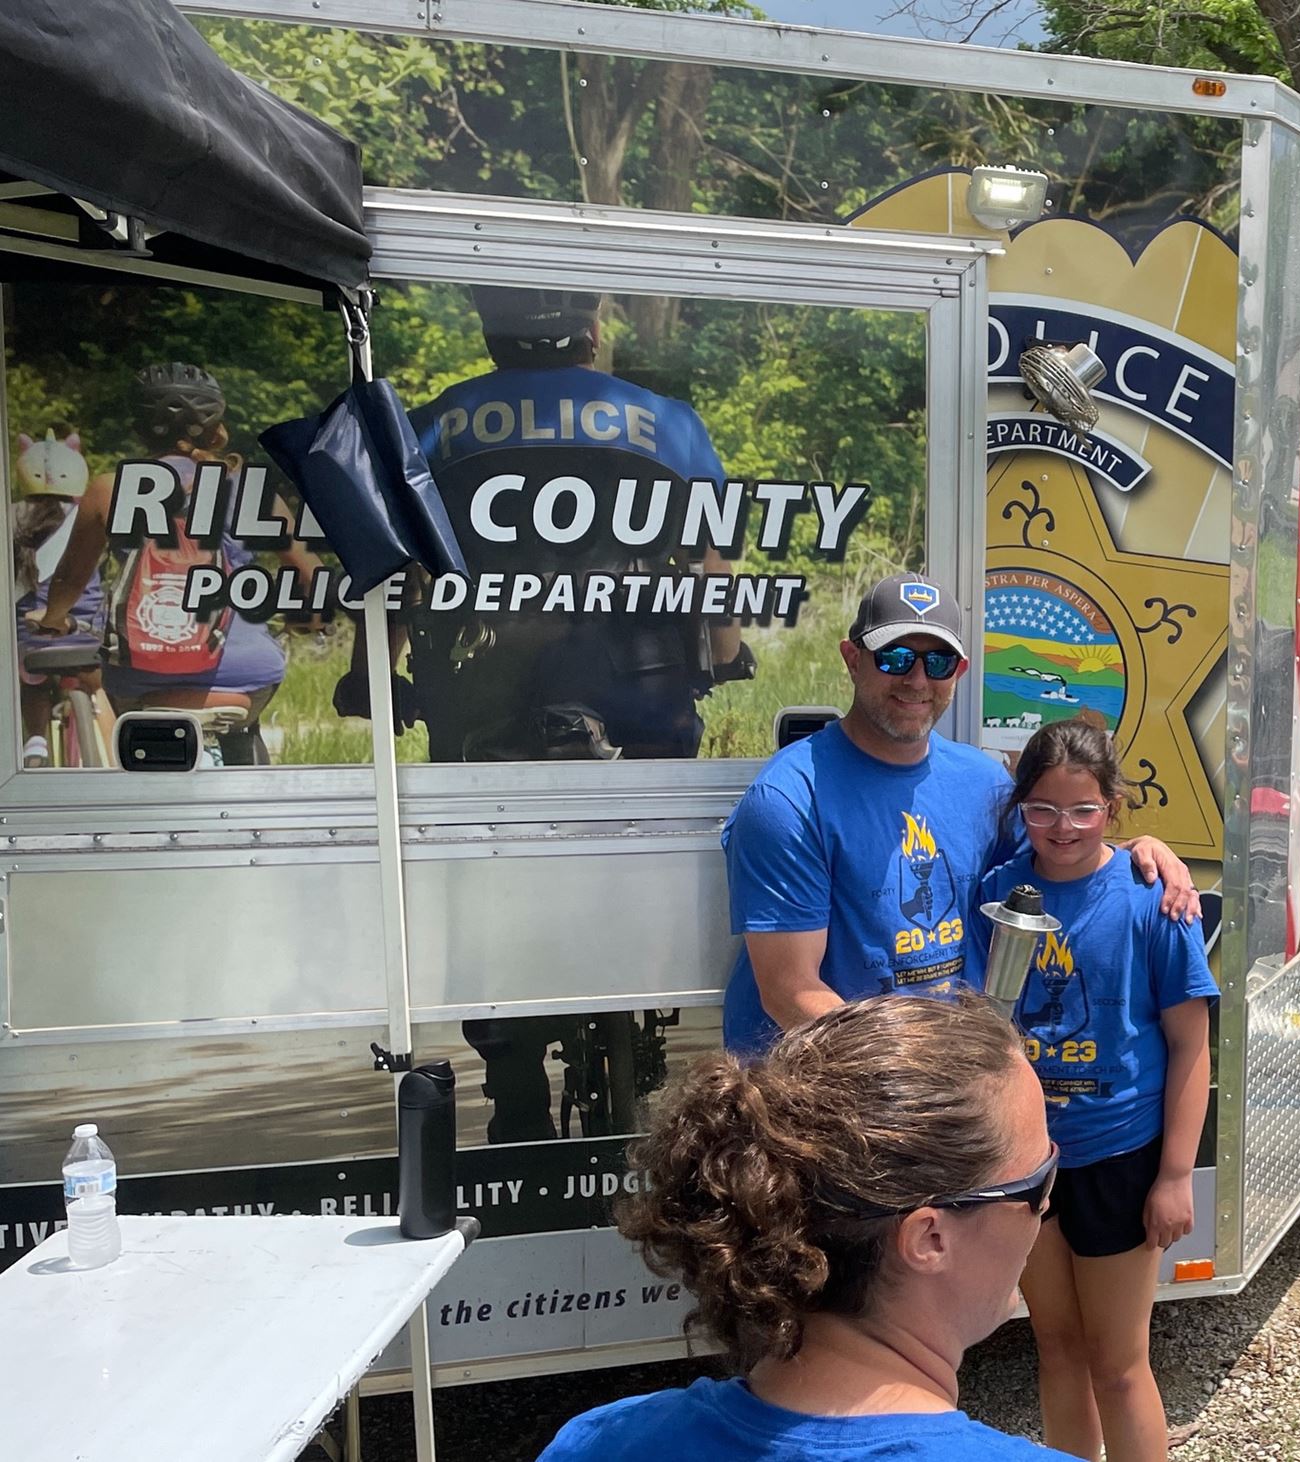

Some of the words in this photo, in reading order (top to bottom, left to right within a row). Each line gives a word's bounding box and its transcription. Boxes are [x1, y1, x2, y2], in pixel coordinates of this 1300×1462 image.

[439, 399, 657, 459] POLICE
[111, 463, 326, 537] RIL
[470, 474, 866, 549] COUNTY
[430, 573, 802, 615] DEPARTMENT
[1025, 574, 1049, 589] PER
[1055, 585, 1096, 622] ASPERA
[872, 888, 895, 899] FORTY
[864, 960, 885, 970] LAW
[890, 949, 948, 968] ENFORCEMENT
[1061, 1040, 1096, 1062] 23
[440, 1300, 491, 1326] the
[507, 1286, 626, 1318] citizens
[642, 1281, 680, 1304] we
